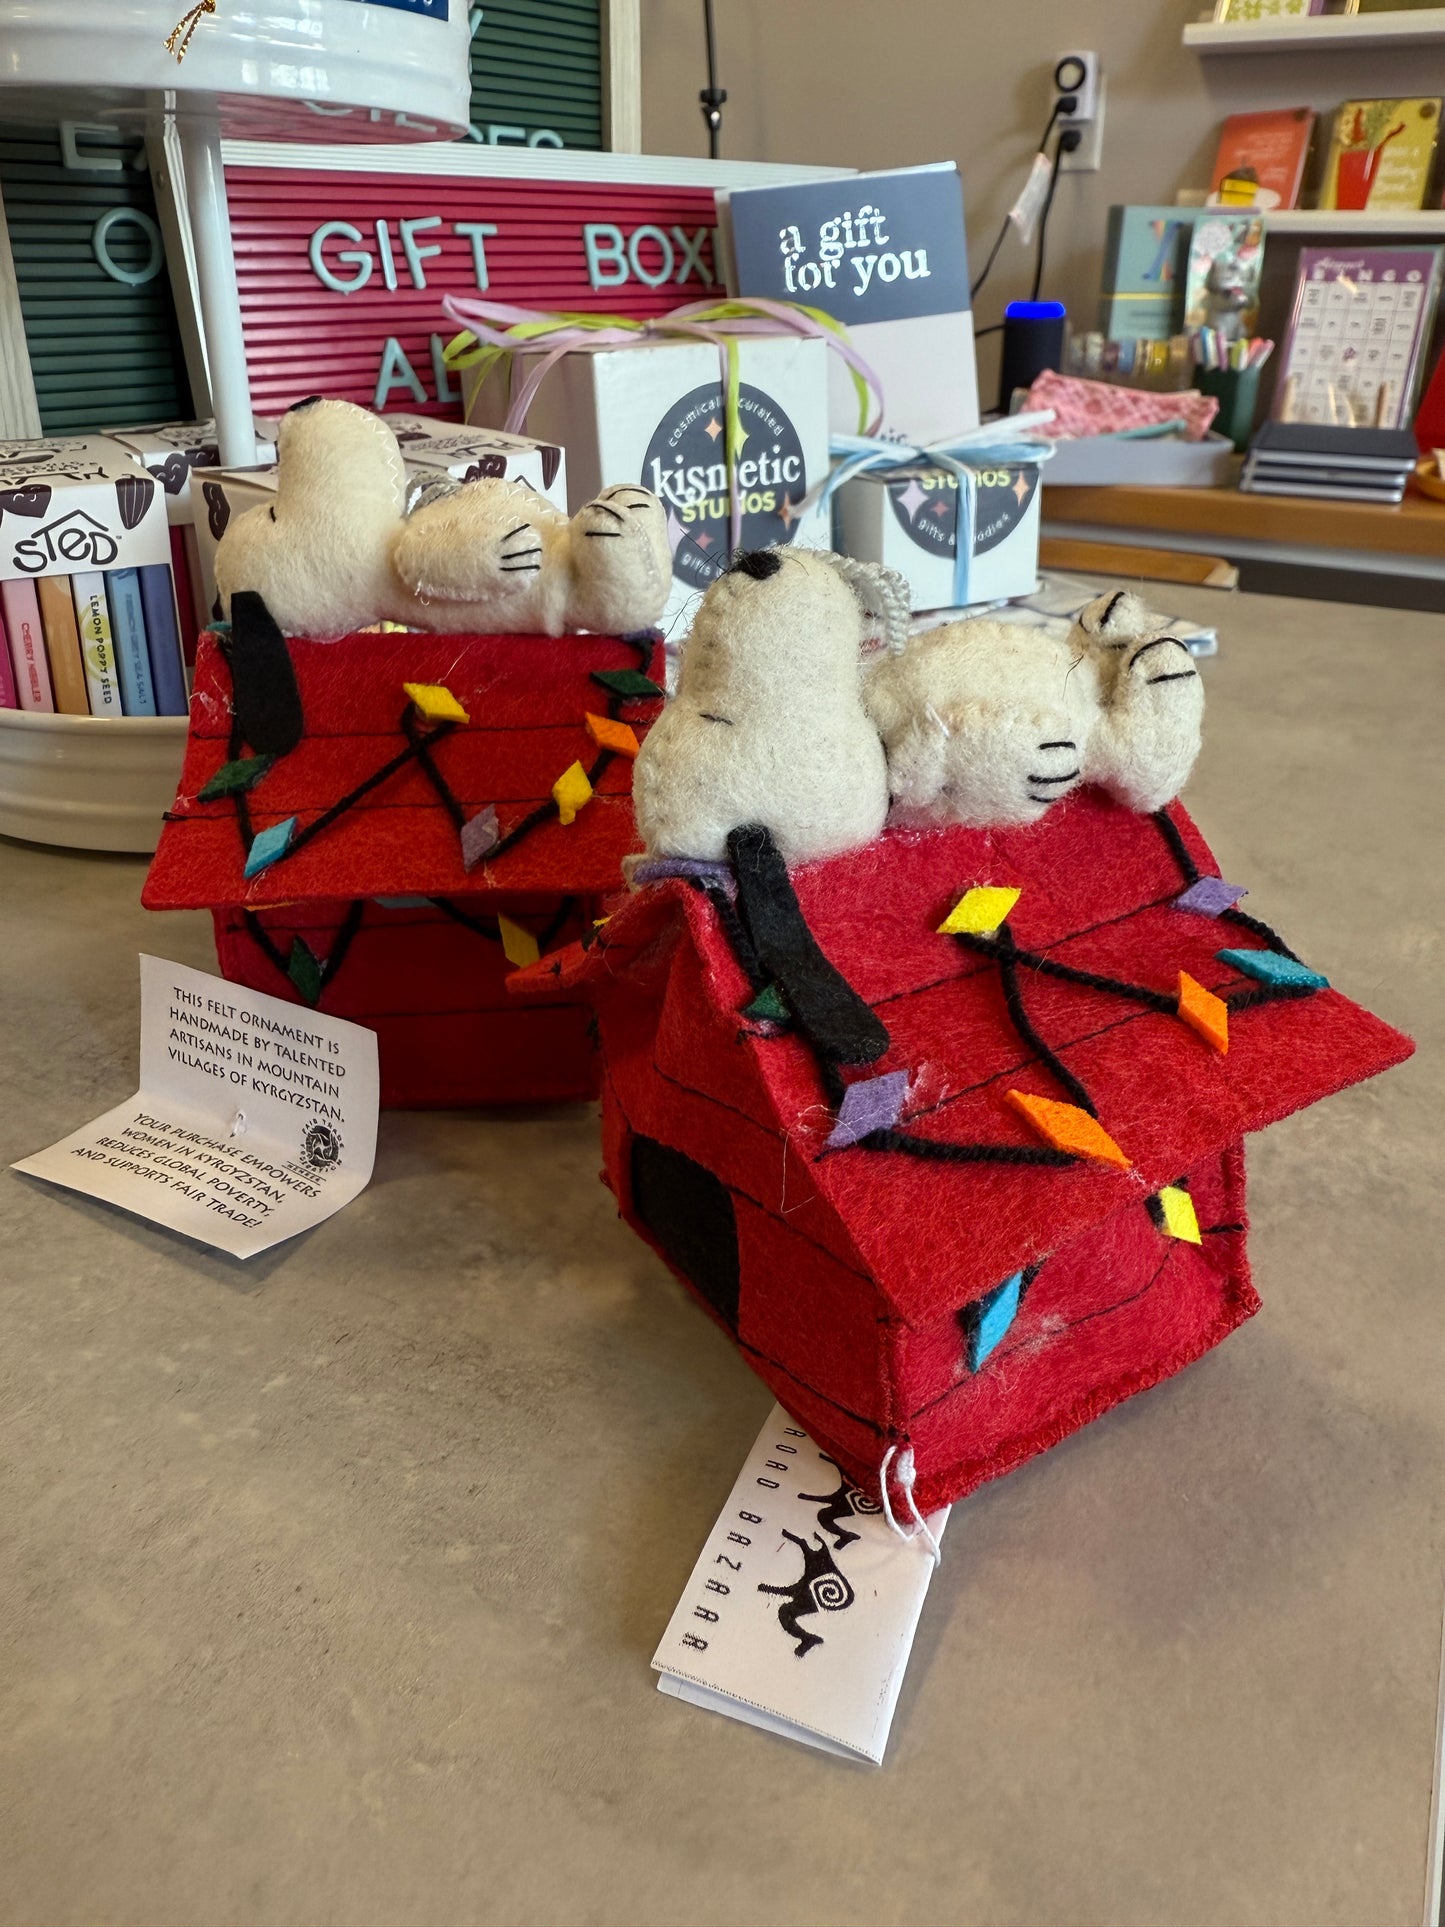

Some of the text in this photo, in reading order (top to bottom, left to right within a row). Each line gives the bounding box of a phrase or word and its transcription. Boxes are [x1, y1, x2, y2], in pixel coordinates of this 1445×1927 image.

[308, 215, 498, 294] GIFT
[779, 205, 890, 261] a gift
[784, 249, 931, 296] for you
[90, 595, 112, 704] LEMON POPPY SEED
[169, 1006, 346, 1077] HANDMADE BY TALENTED
[173, 986, 340, 1054] THIS FELT ORNAMENT IS
[168, 1046, 345, 1123] VILLAGES OF KYRGYZSTAN.
[169, 1028, 340, 1099] ARTISANS IN MOUNTAIN
[70, 1147, 263, 1229] AND SUPPORTS FAIR TRADE!
[96, 1136, 152, 1159] REDUCES
[153, 1154, 204, 1181] GLOBAL
[122, 1127, 286, 1204] WOMEN IN KYRGYZSTAN,
[133, 1113, 322, 1200] YOUR PURCHASE EMPOWERS
[680, 1427, 807, 1652] ROAD BAZAAR
